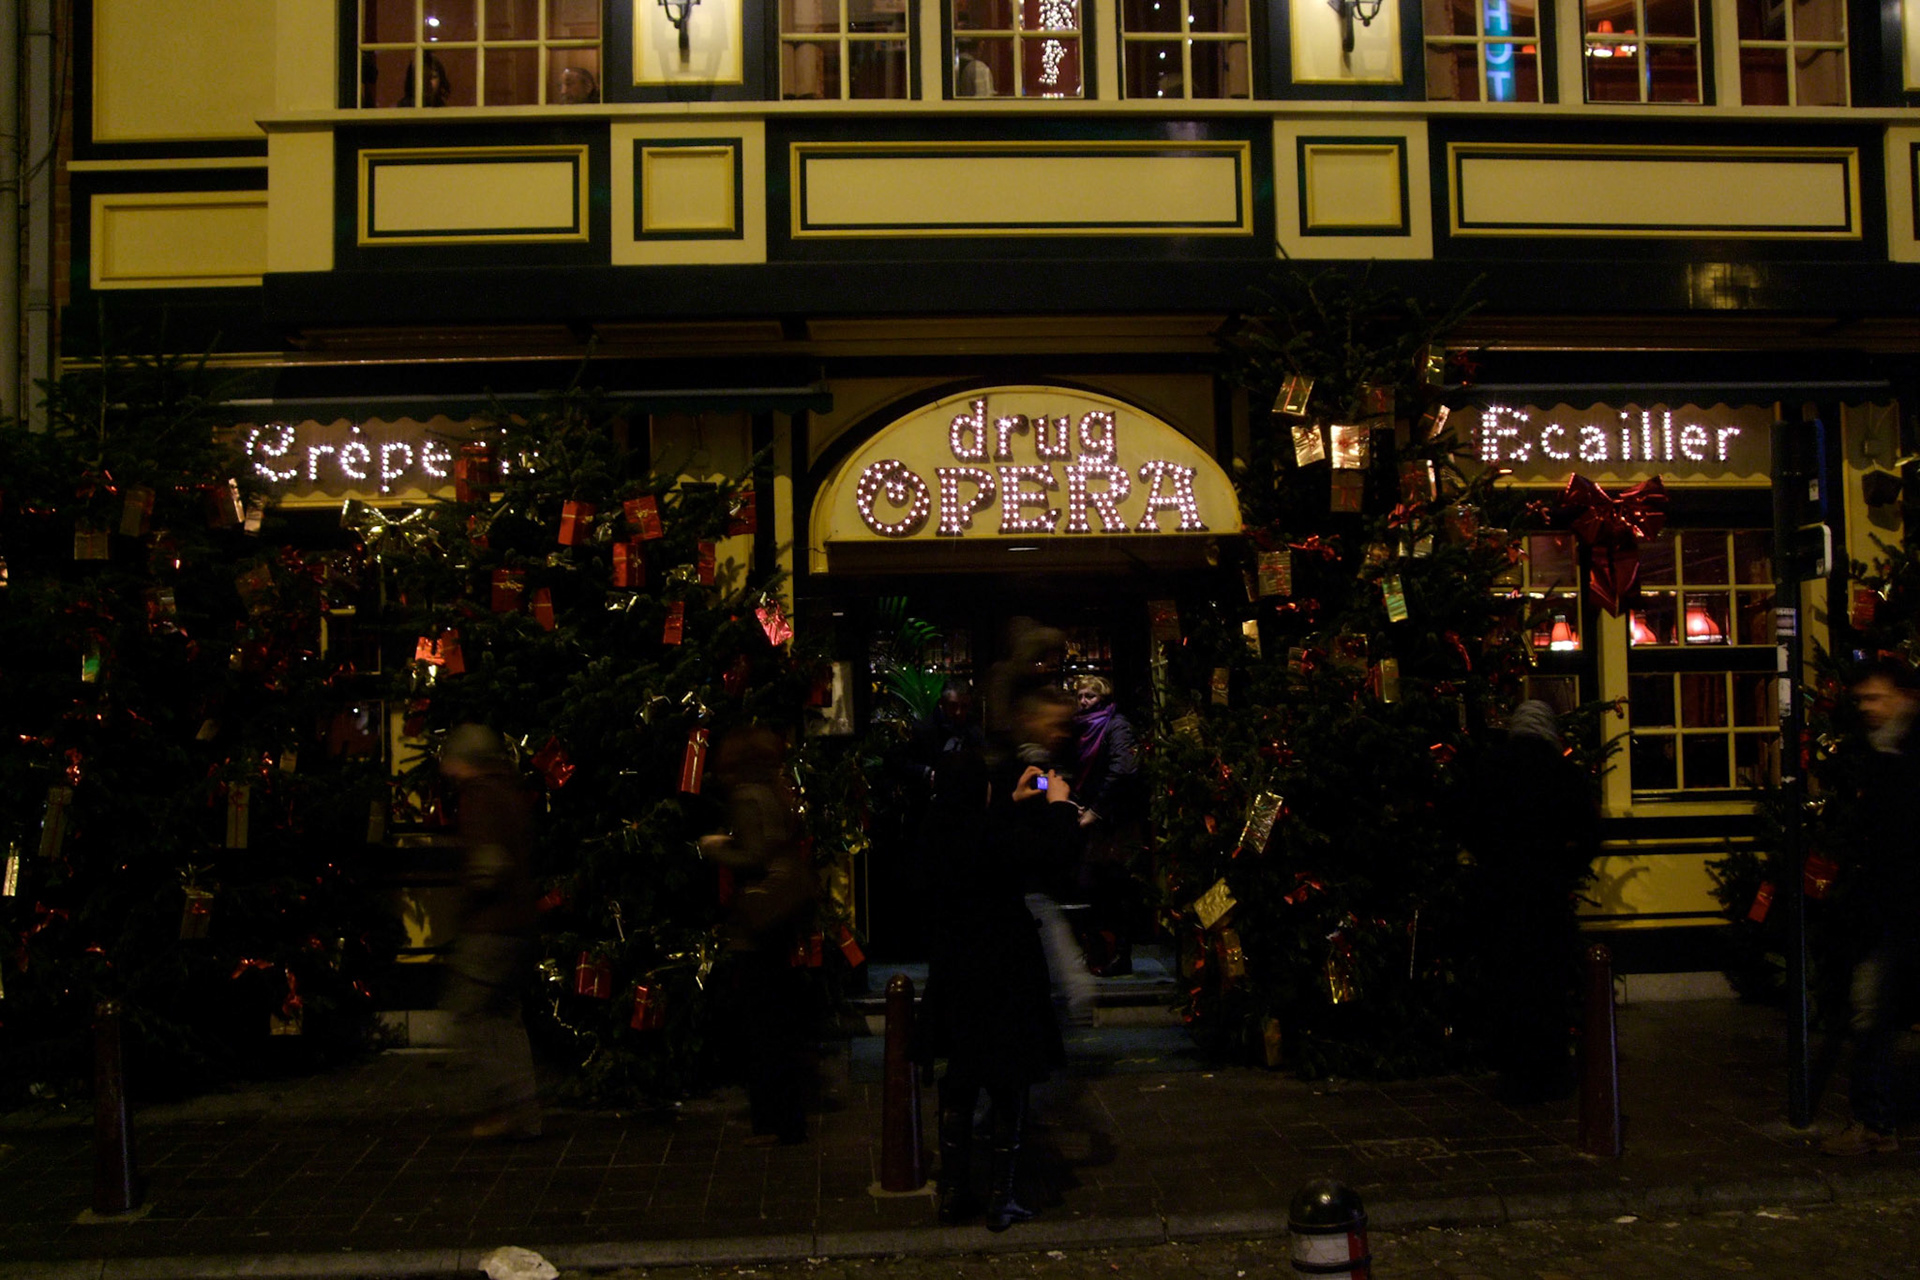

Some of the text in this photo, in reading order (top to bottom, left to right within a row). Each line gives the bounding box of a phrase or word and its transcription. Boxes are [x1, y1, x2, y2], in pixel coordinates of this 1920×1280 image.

[948, 395, 1118, 465] drug
[1480, 404, 1742, 462] Ecailler
[856, 458, 1210, 538] OPERA
